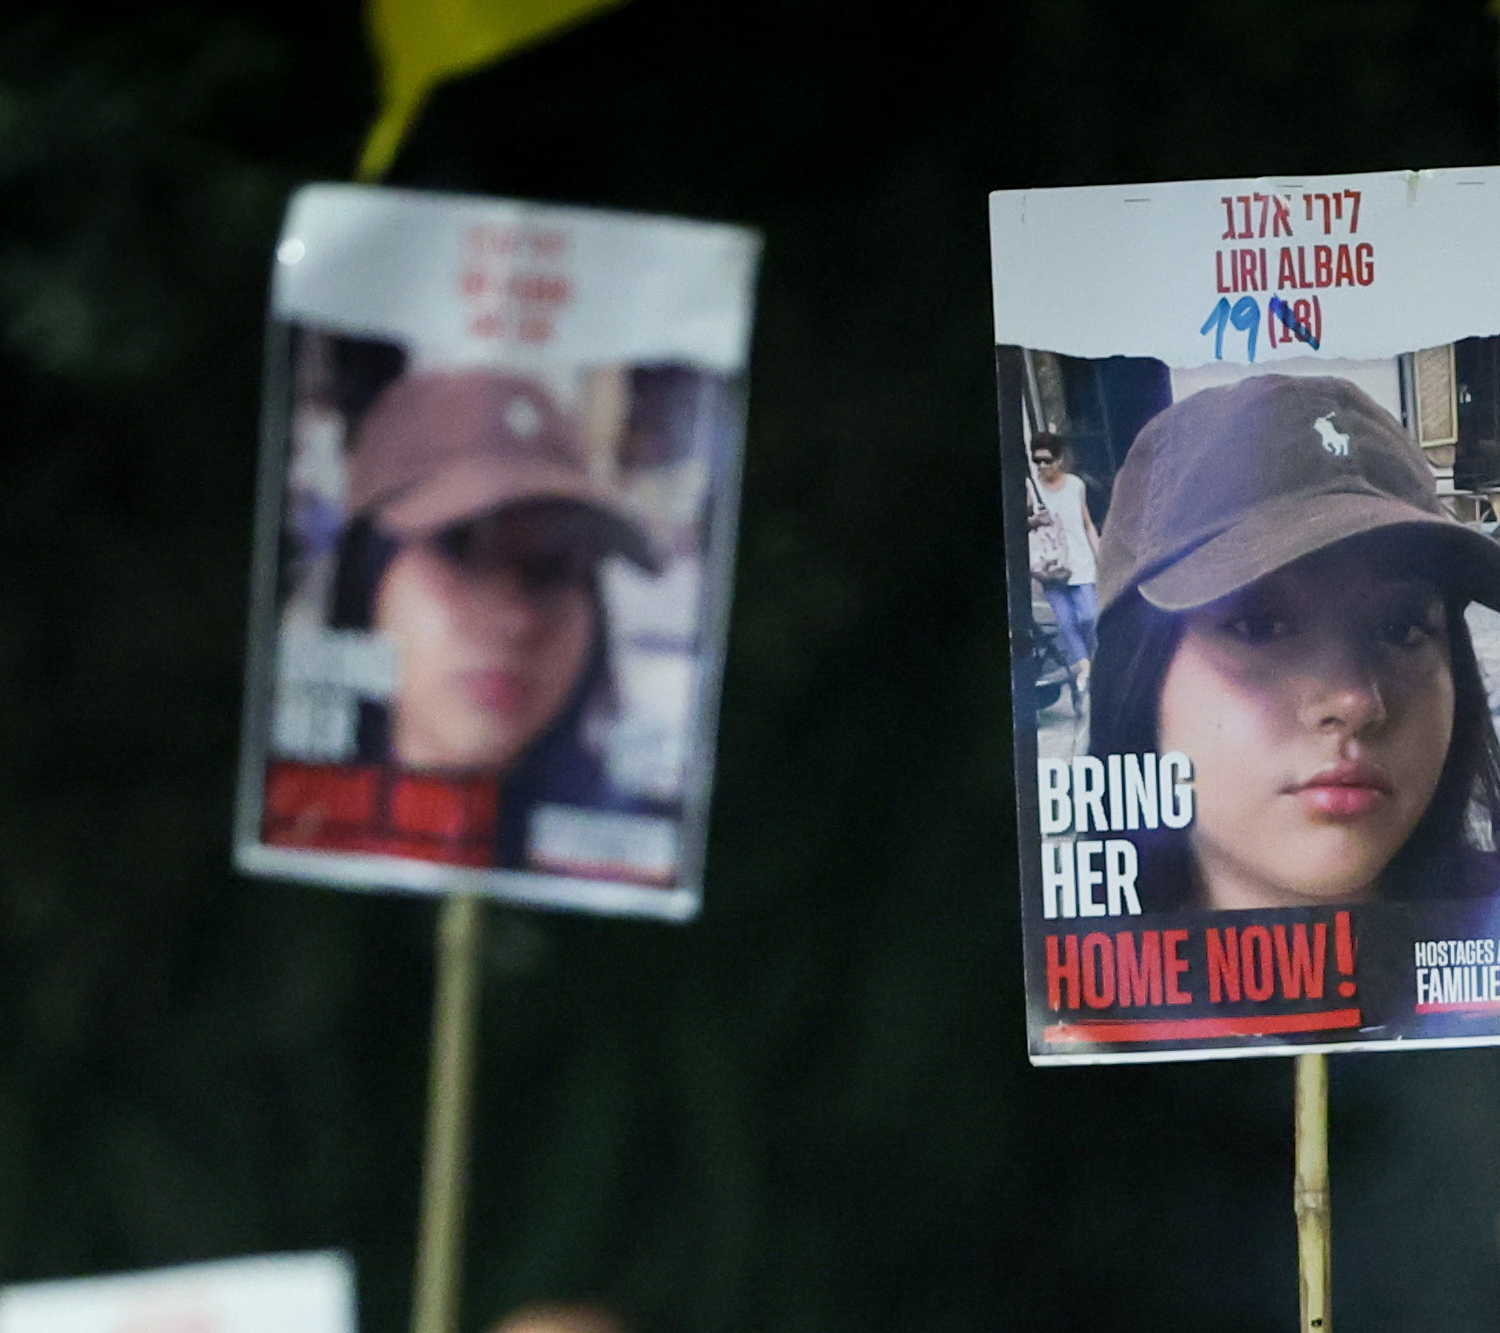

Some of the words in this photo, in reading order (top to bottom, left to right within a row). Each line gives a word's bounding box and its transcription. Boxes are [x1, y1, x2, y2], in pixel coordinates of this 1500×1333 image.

[1221, 191, 1293, 240] אלבג
[1303, 188, 1362, 236] לירי
[1216, 248, 1269, 294] LIRI
[1278, 242, 1375, 290] ALBAG
[1200, 296, 1261, 362] 19
[1038, 752, 1194, 834] BRING
[1041, 839, 1143, 919] HER
[1046, 928, 1193, 1010] HOME
[1207, 911, 1357, 1003] NOW!
[1415, 940, 1496, 967] HOSTAGES
